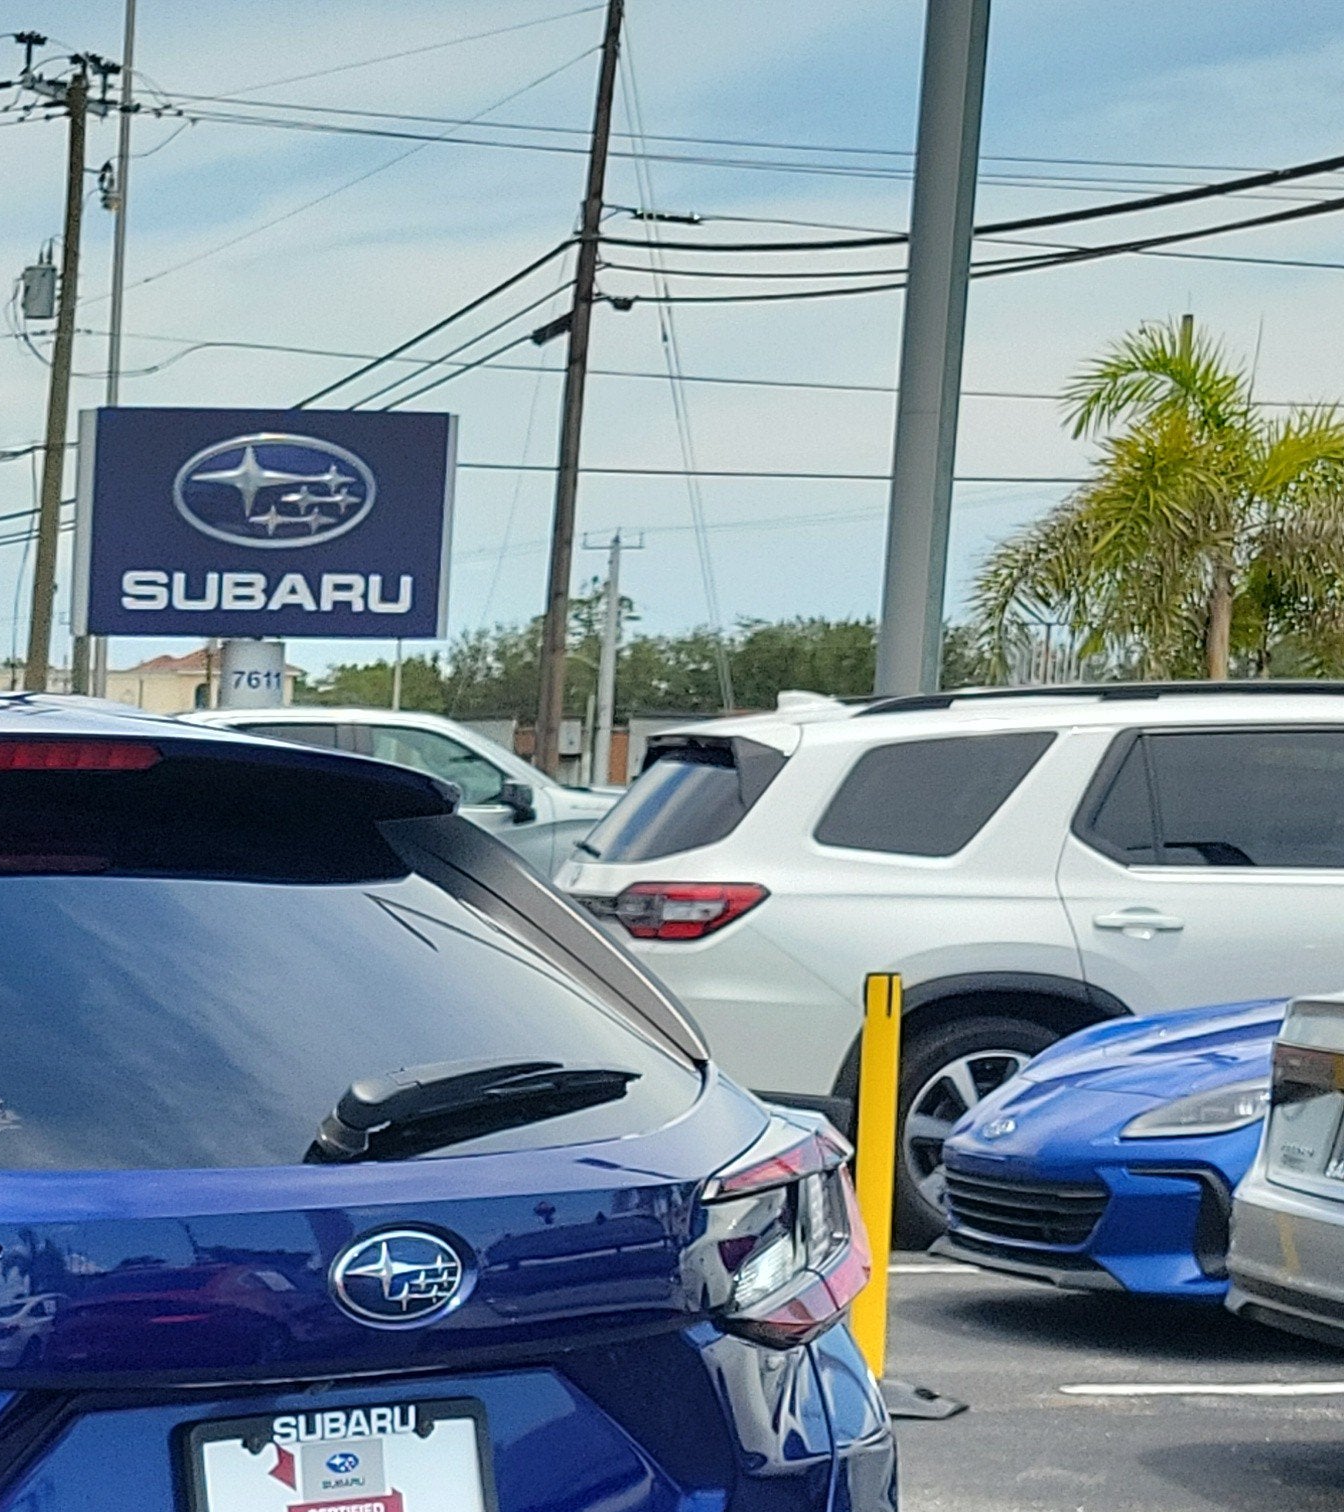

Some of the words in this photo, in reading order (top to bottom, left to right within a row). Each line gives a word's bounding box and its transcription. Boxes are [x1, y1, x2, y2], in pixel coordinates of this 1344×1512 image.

[121, 570, 414, 614] SUBARU
[232, 669, 282, 690] 7611
[273, 1405, 417, 1443] SUBARU
